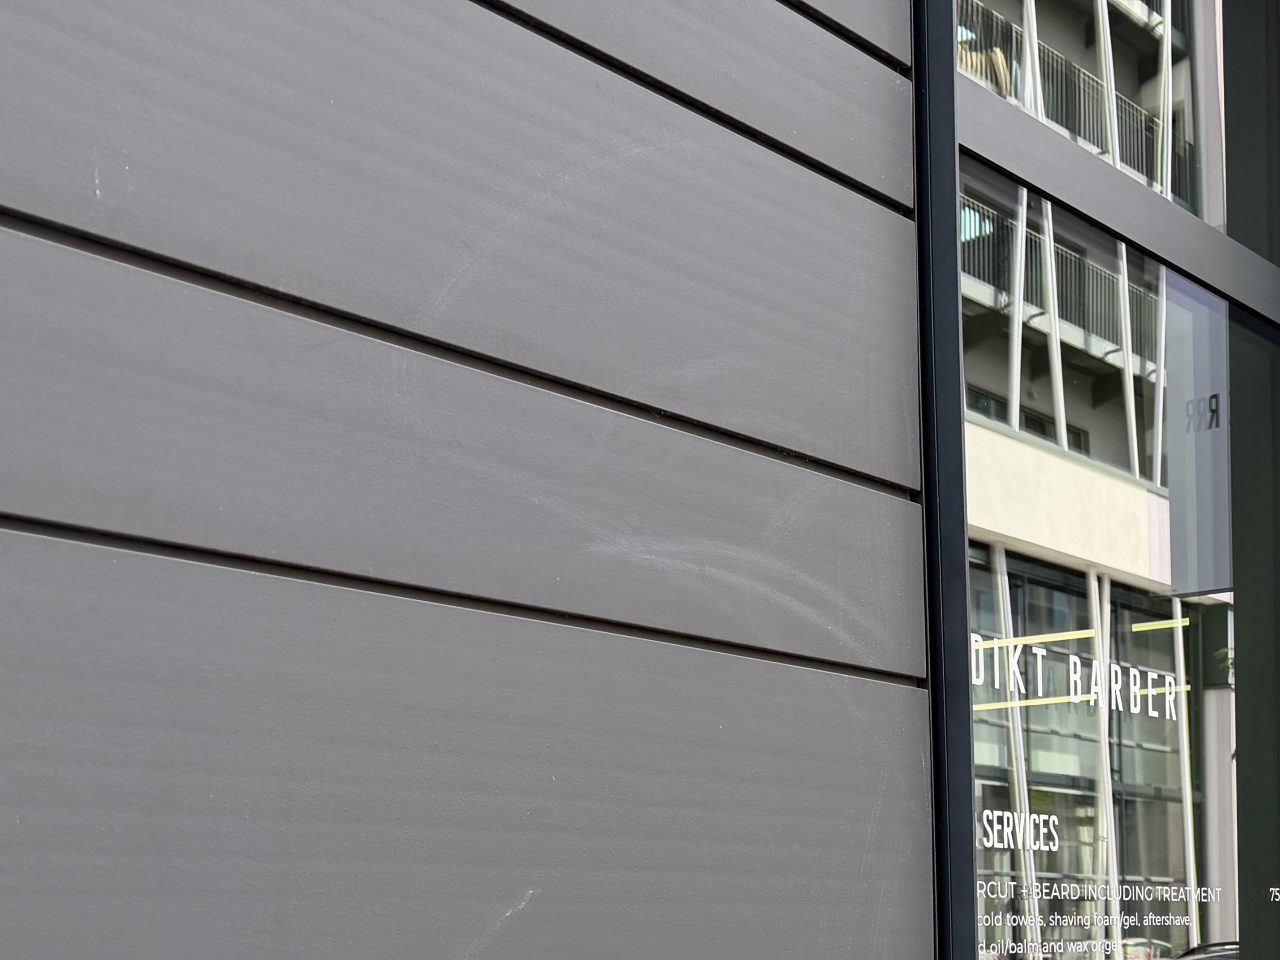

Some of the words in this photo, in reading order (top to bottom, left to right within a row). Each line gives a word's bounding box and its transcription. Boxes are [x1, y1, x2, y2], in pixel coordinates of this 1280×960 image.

[970, 632, 1047, 698] DIKT
[1069, 654, 1178, 722] BARBER
[982, 809, 1060, 852] SERVICES
[976, 880, 1017, 899] RCUT
[1020, 886, 1029, 898] +
[1032, 882, 1081, 900] BEARD
[1084, 884, 1153, 901] INCLUDING
[1154, 886, 1222, 903] TREATMENT
[1006, 912, 1046, 928] towels,
[1049, 911, 1091, 929] shaving
[1093, 910, 1141, 930] foam/gel,
[1142, 911, 1193, 929] aftershave,
[989, 938, 1040, 956] oil/balm
[1042, 938, 1065, 953] and
[1066, 941, 1088, 953] wax
[1091, 941, 1103, 952] or
